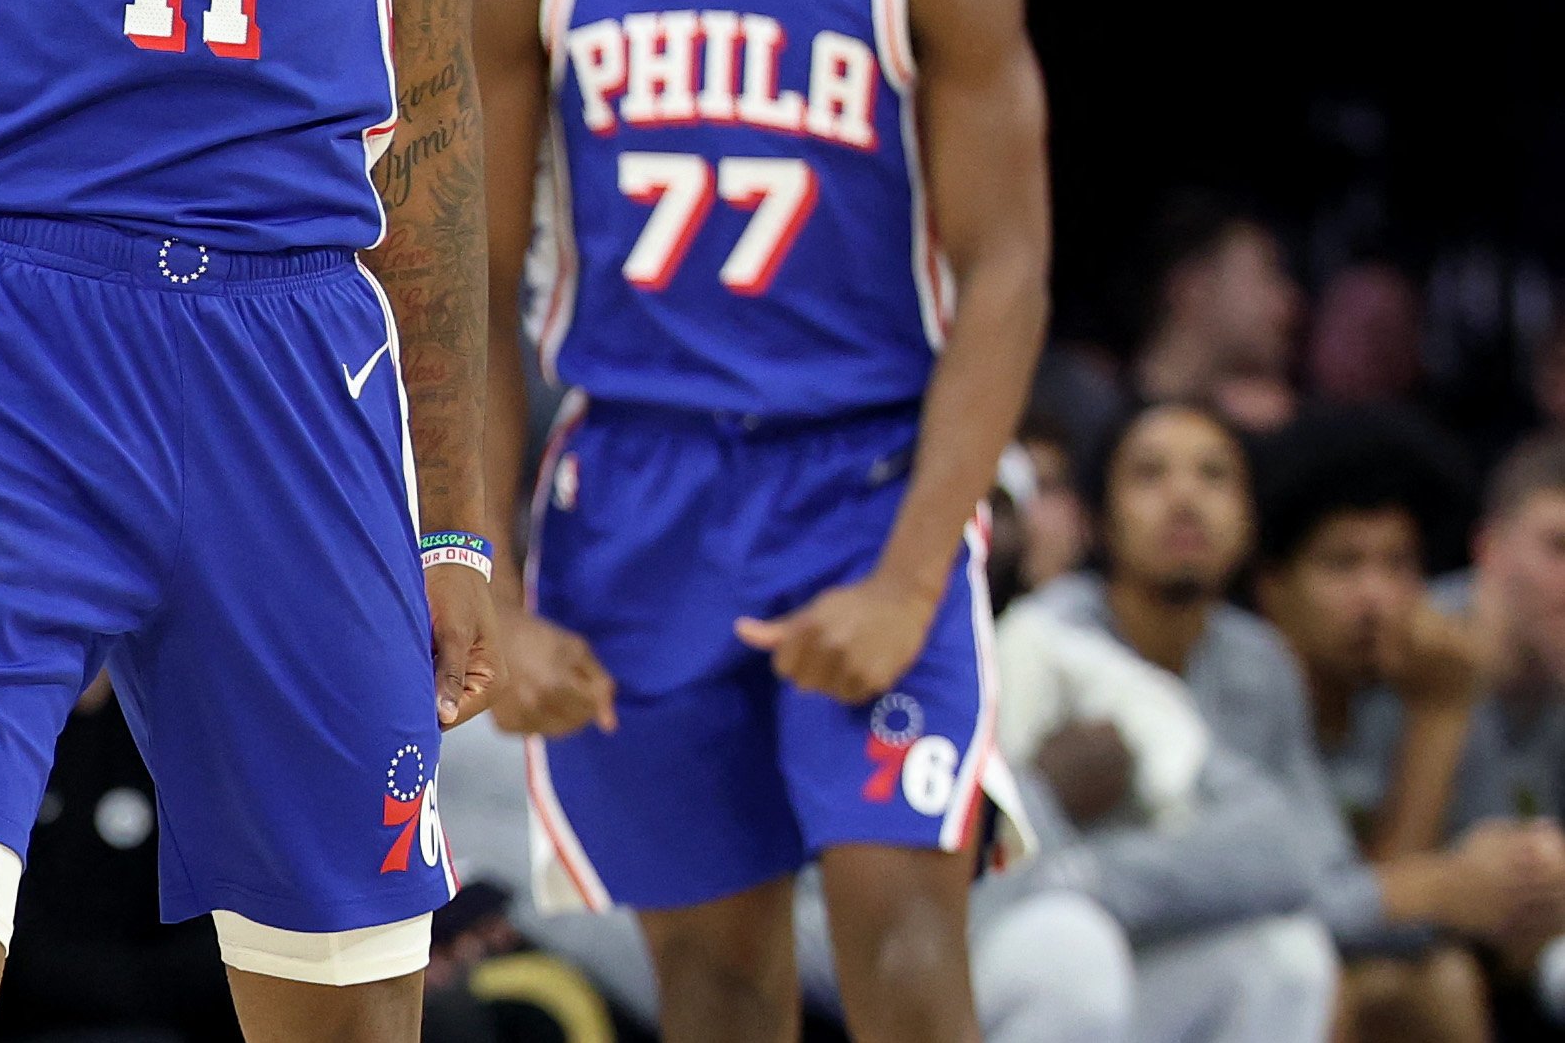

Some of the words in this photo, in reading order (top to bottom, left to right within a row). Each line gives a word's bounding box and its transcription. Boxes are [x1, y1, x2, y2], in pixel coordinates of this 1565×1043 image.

[567, 9, 879, 152] PHILA
[618, 151, 820, 297] 77
[446, 548, 483, 569] ONLY
[860, 732, 959, 818] 76
[380, 779, 440, 875] 76
